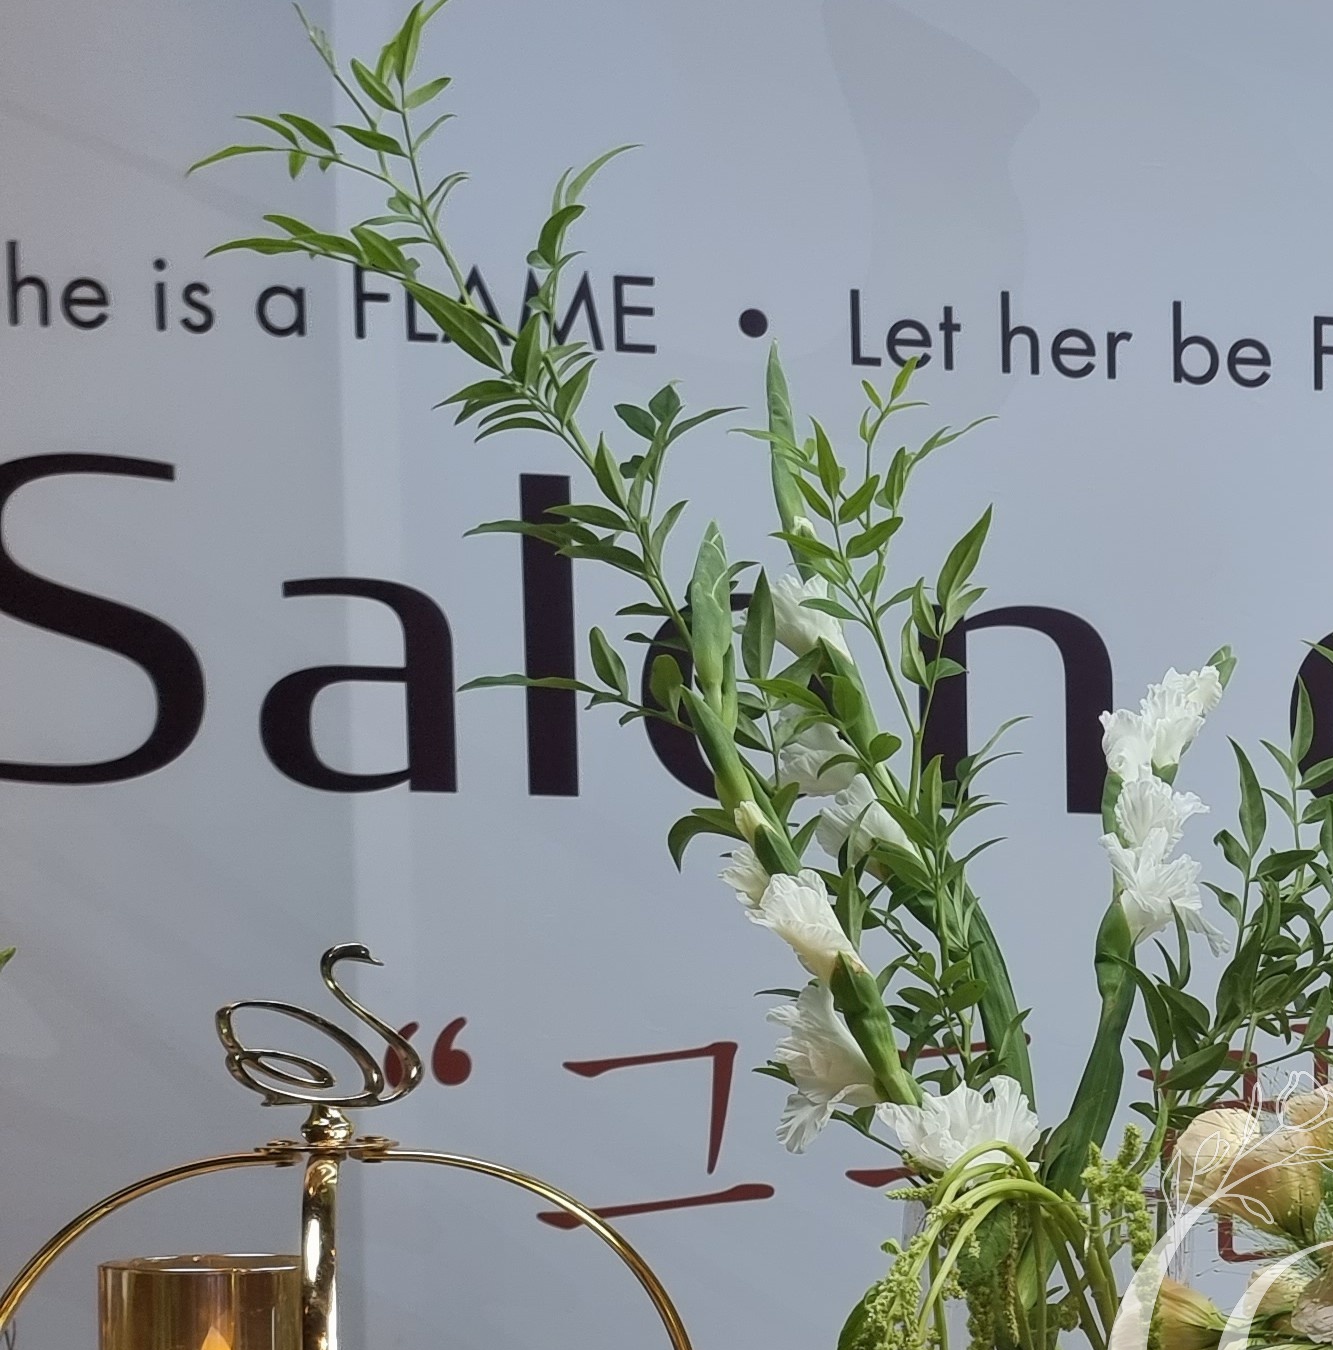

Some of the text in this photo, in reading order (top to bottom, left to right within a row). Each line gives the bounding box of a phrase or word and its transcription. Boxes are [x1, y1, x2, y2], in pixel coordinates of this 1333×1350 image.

[152, 257, 215, 335] is
[255, 284, 309, 338] a
[353, 262, 657, 354] FLAME
[850, 288, 962, 372] Let
[1000, 290, 1132, 380] her
[1172, 300, 1272, 389] be
